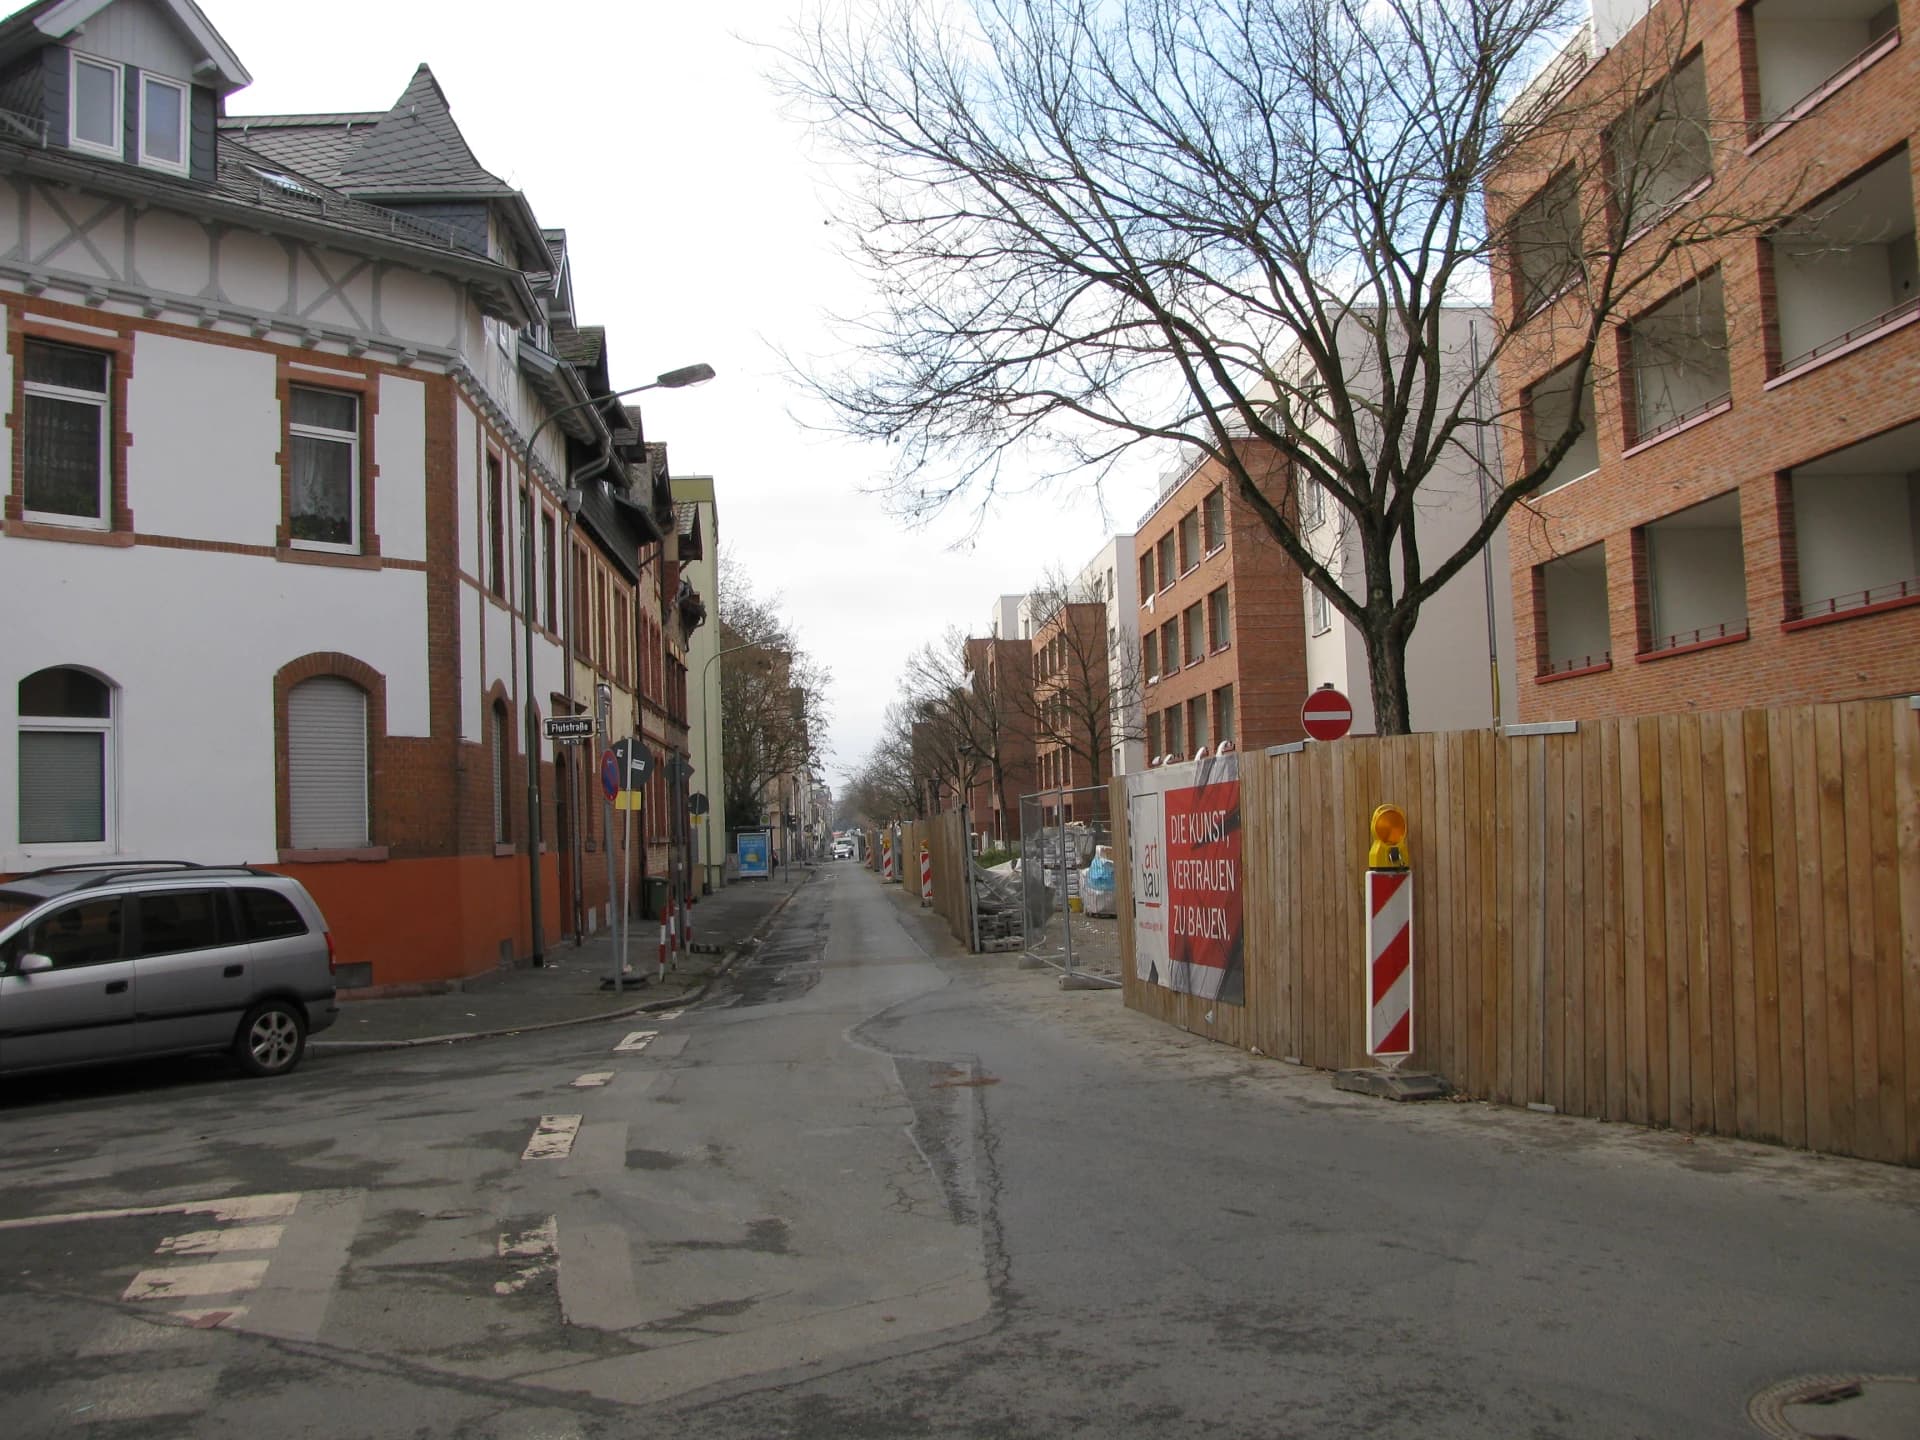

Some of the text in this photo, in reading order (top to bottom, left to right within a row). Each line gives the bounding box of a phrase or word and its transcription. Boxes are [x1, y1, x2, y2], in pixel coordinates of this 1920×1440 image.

[552, 721, 588, 733] Flutstraße
[1171, 810, 1230, 848] DIE KUNST,
[1144, 837, 1159, 869] art
[1141, 864, 1160, 898] bau
[1172, 859, 1235, 892] VERTRAUEN
[1173, 905, 1230, 941] ZU BAUEN.
